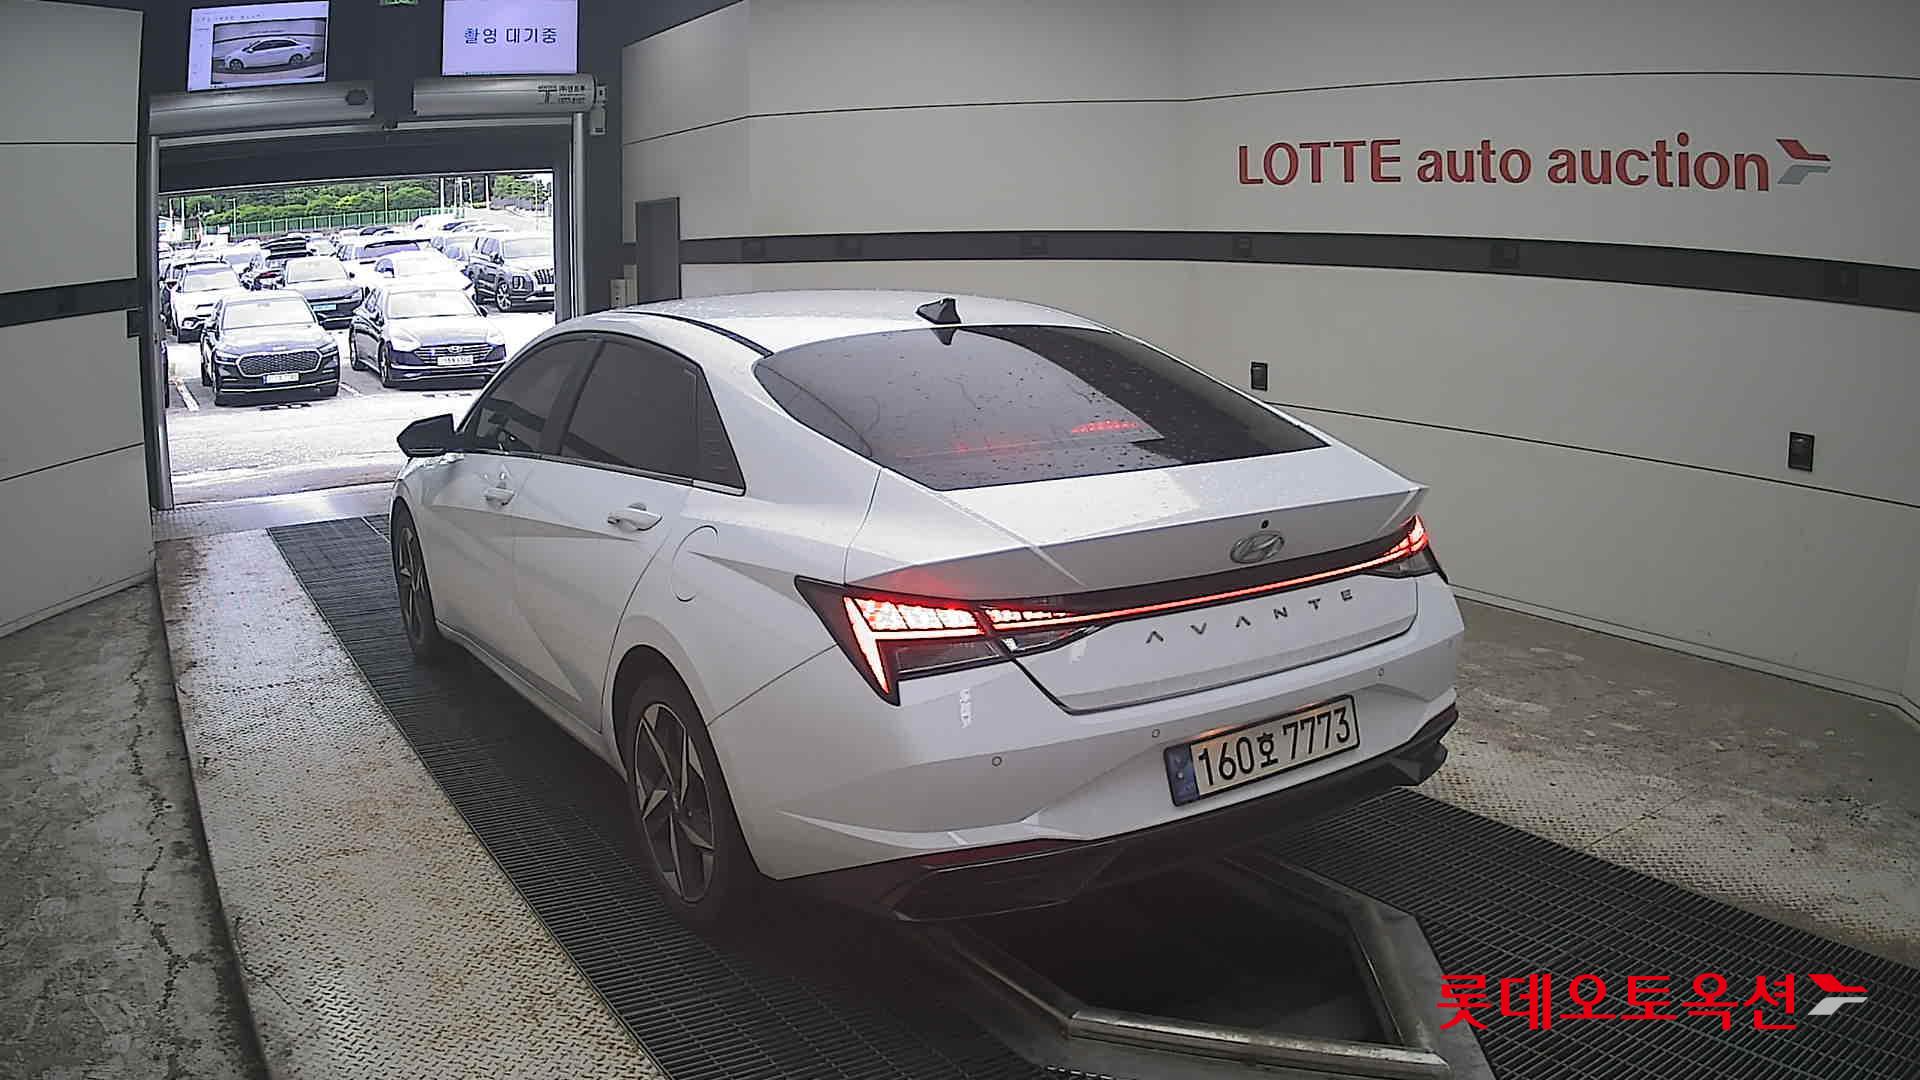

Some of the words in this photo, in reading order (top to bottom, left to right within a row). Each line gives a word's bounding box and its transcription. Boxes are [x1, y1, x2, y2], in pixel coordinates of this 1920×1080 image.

[464, 28, 497, 44] 촬영
[506, 27, 557, 44] 대기중
[1239, 138, 1401, 185] LOTTE
[1416, 139, 1532, 184] auto
[1547, 131, 1769, 192] auction
[1146, 589, 1354, 644] AVANTE
[1282, 706, 1350, 760] 7773
